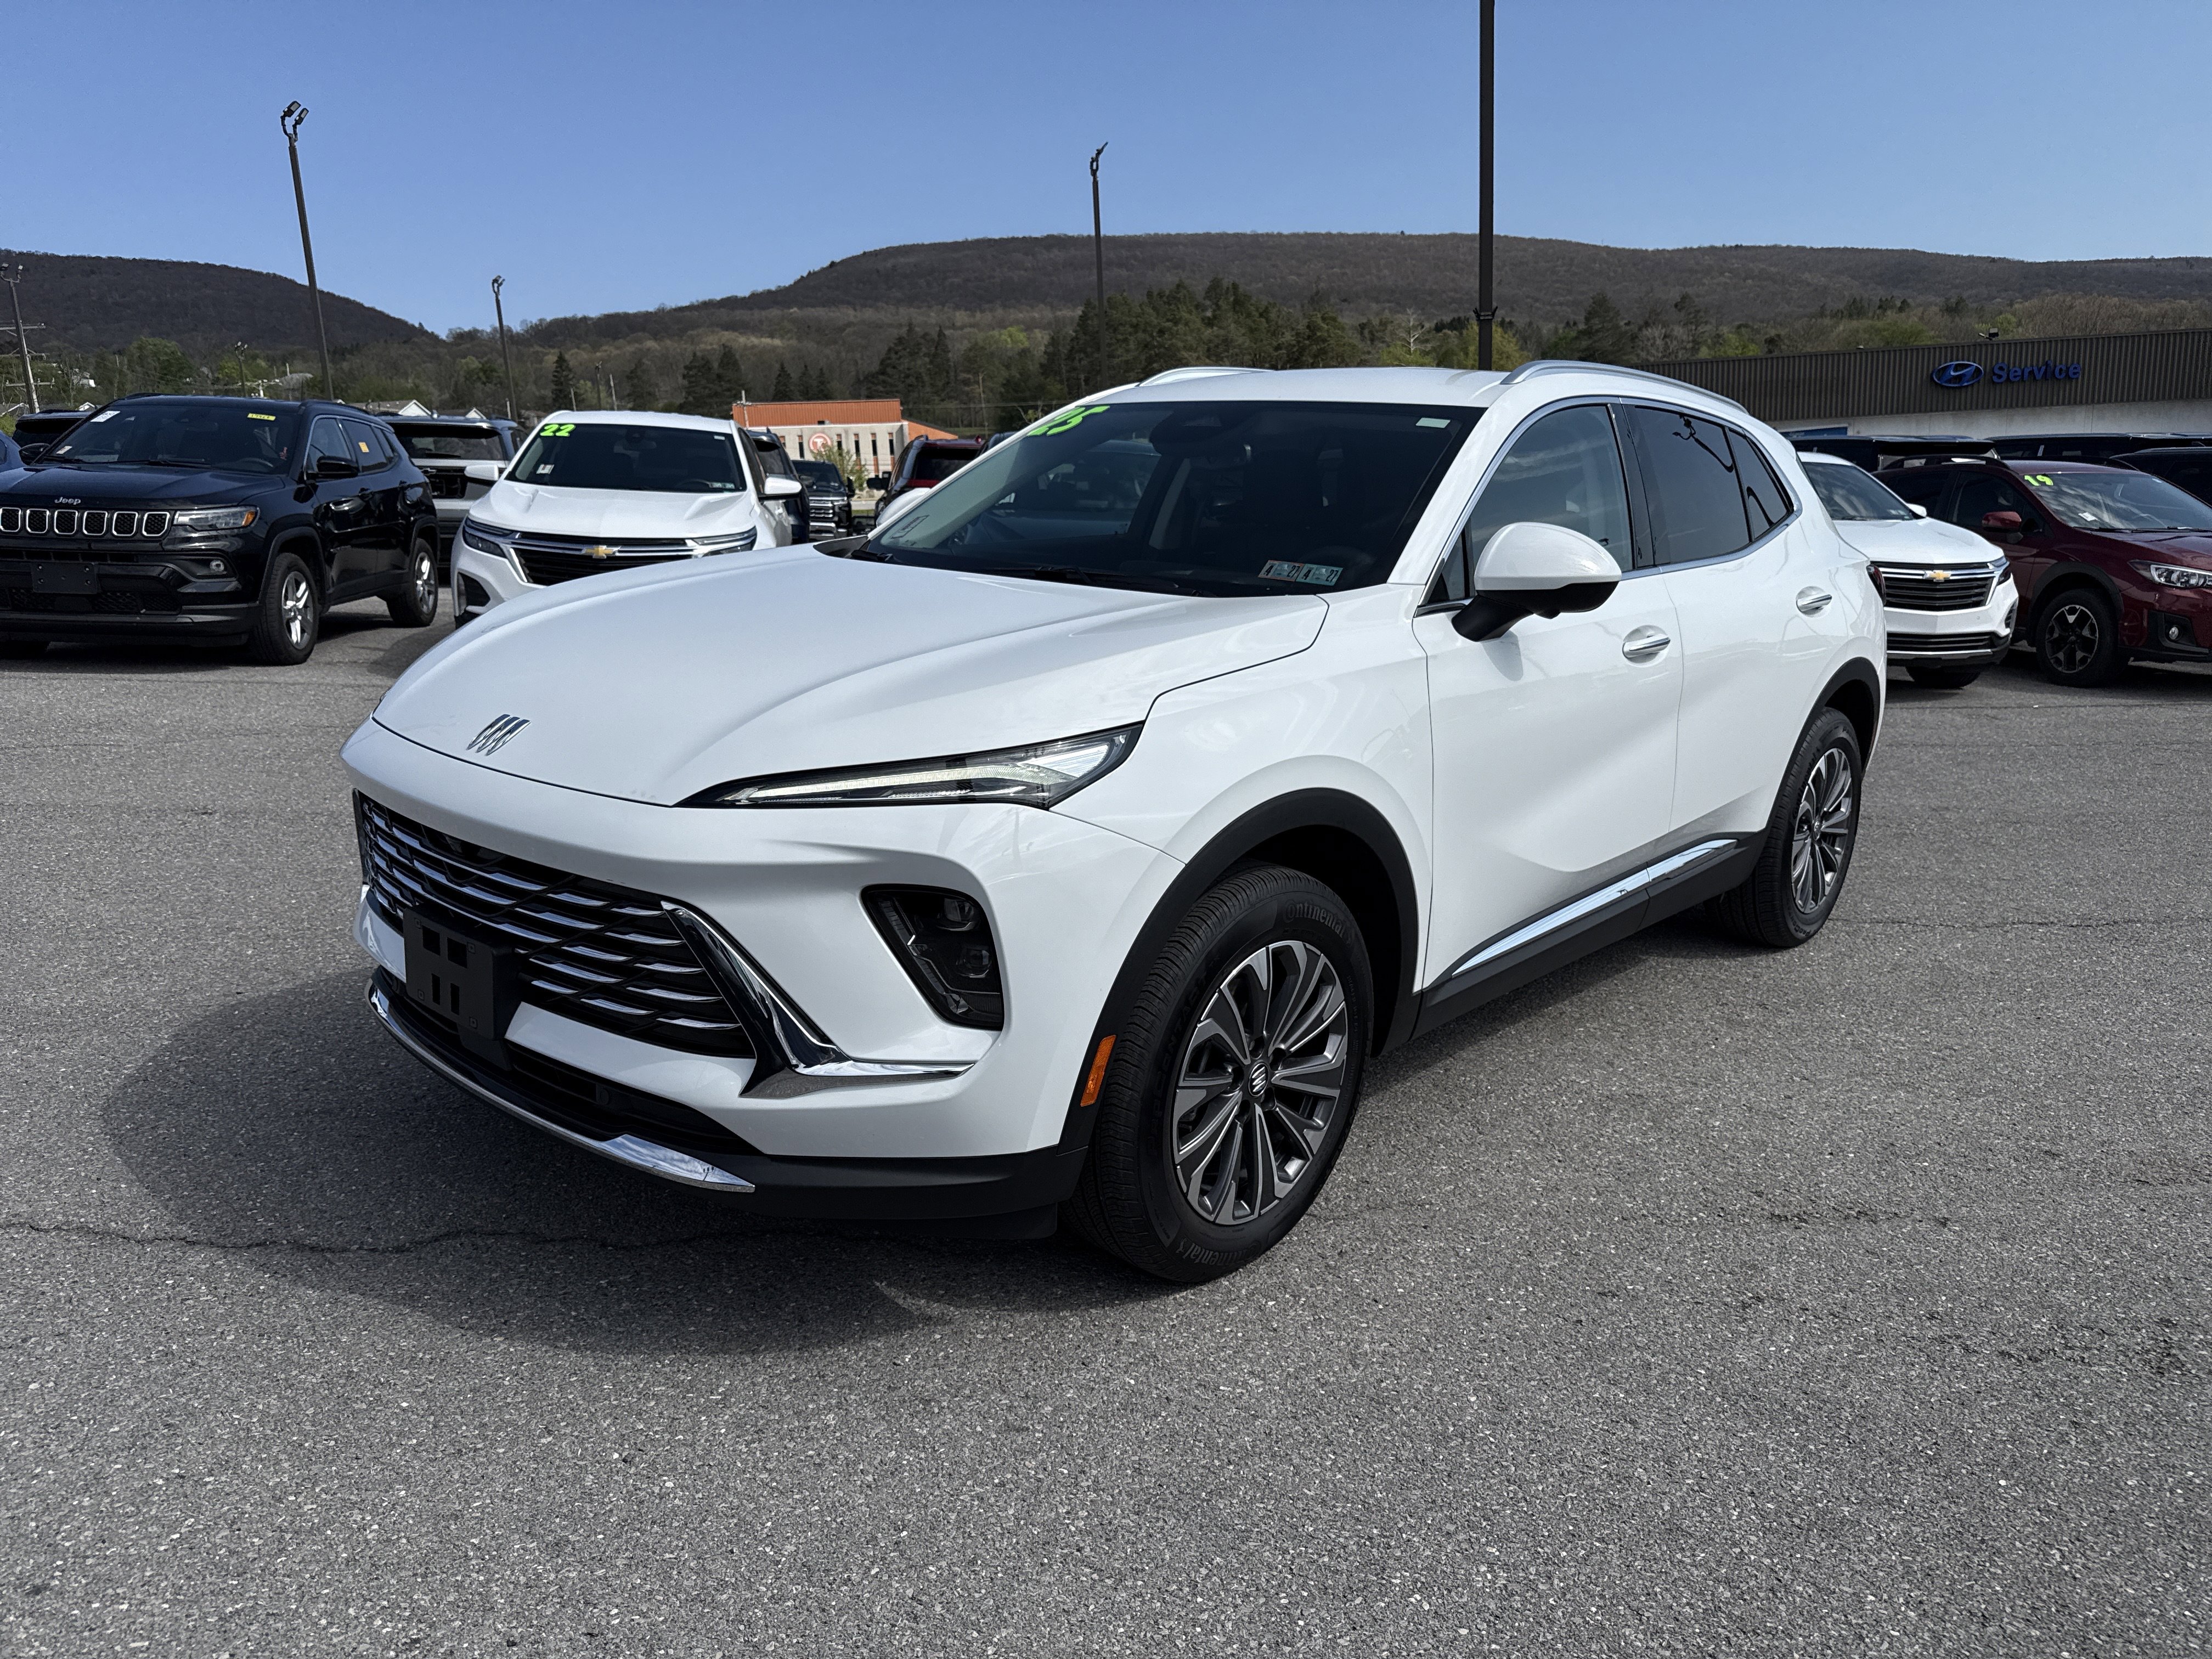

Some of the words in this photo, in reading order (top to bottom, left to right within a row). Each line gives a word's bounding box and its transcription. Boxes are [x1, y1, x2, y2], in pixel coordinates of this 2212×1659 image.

[1992, 360, 2081, 383] Service
[1027, 406, 1110, 437] 25
[540, 424, 575, 437] 22
[2024, 475, 2053, 486] 19
[54, 496, 81, 505] Jeep
[1286, 565, 1301, 578] 27
[1325, 569, 1339, 582] 27
[1283, 900, 1346, 938] Continental
